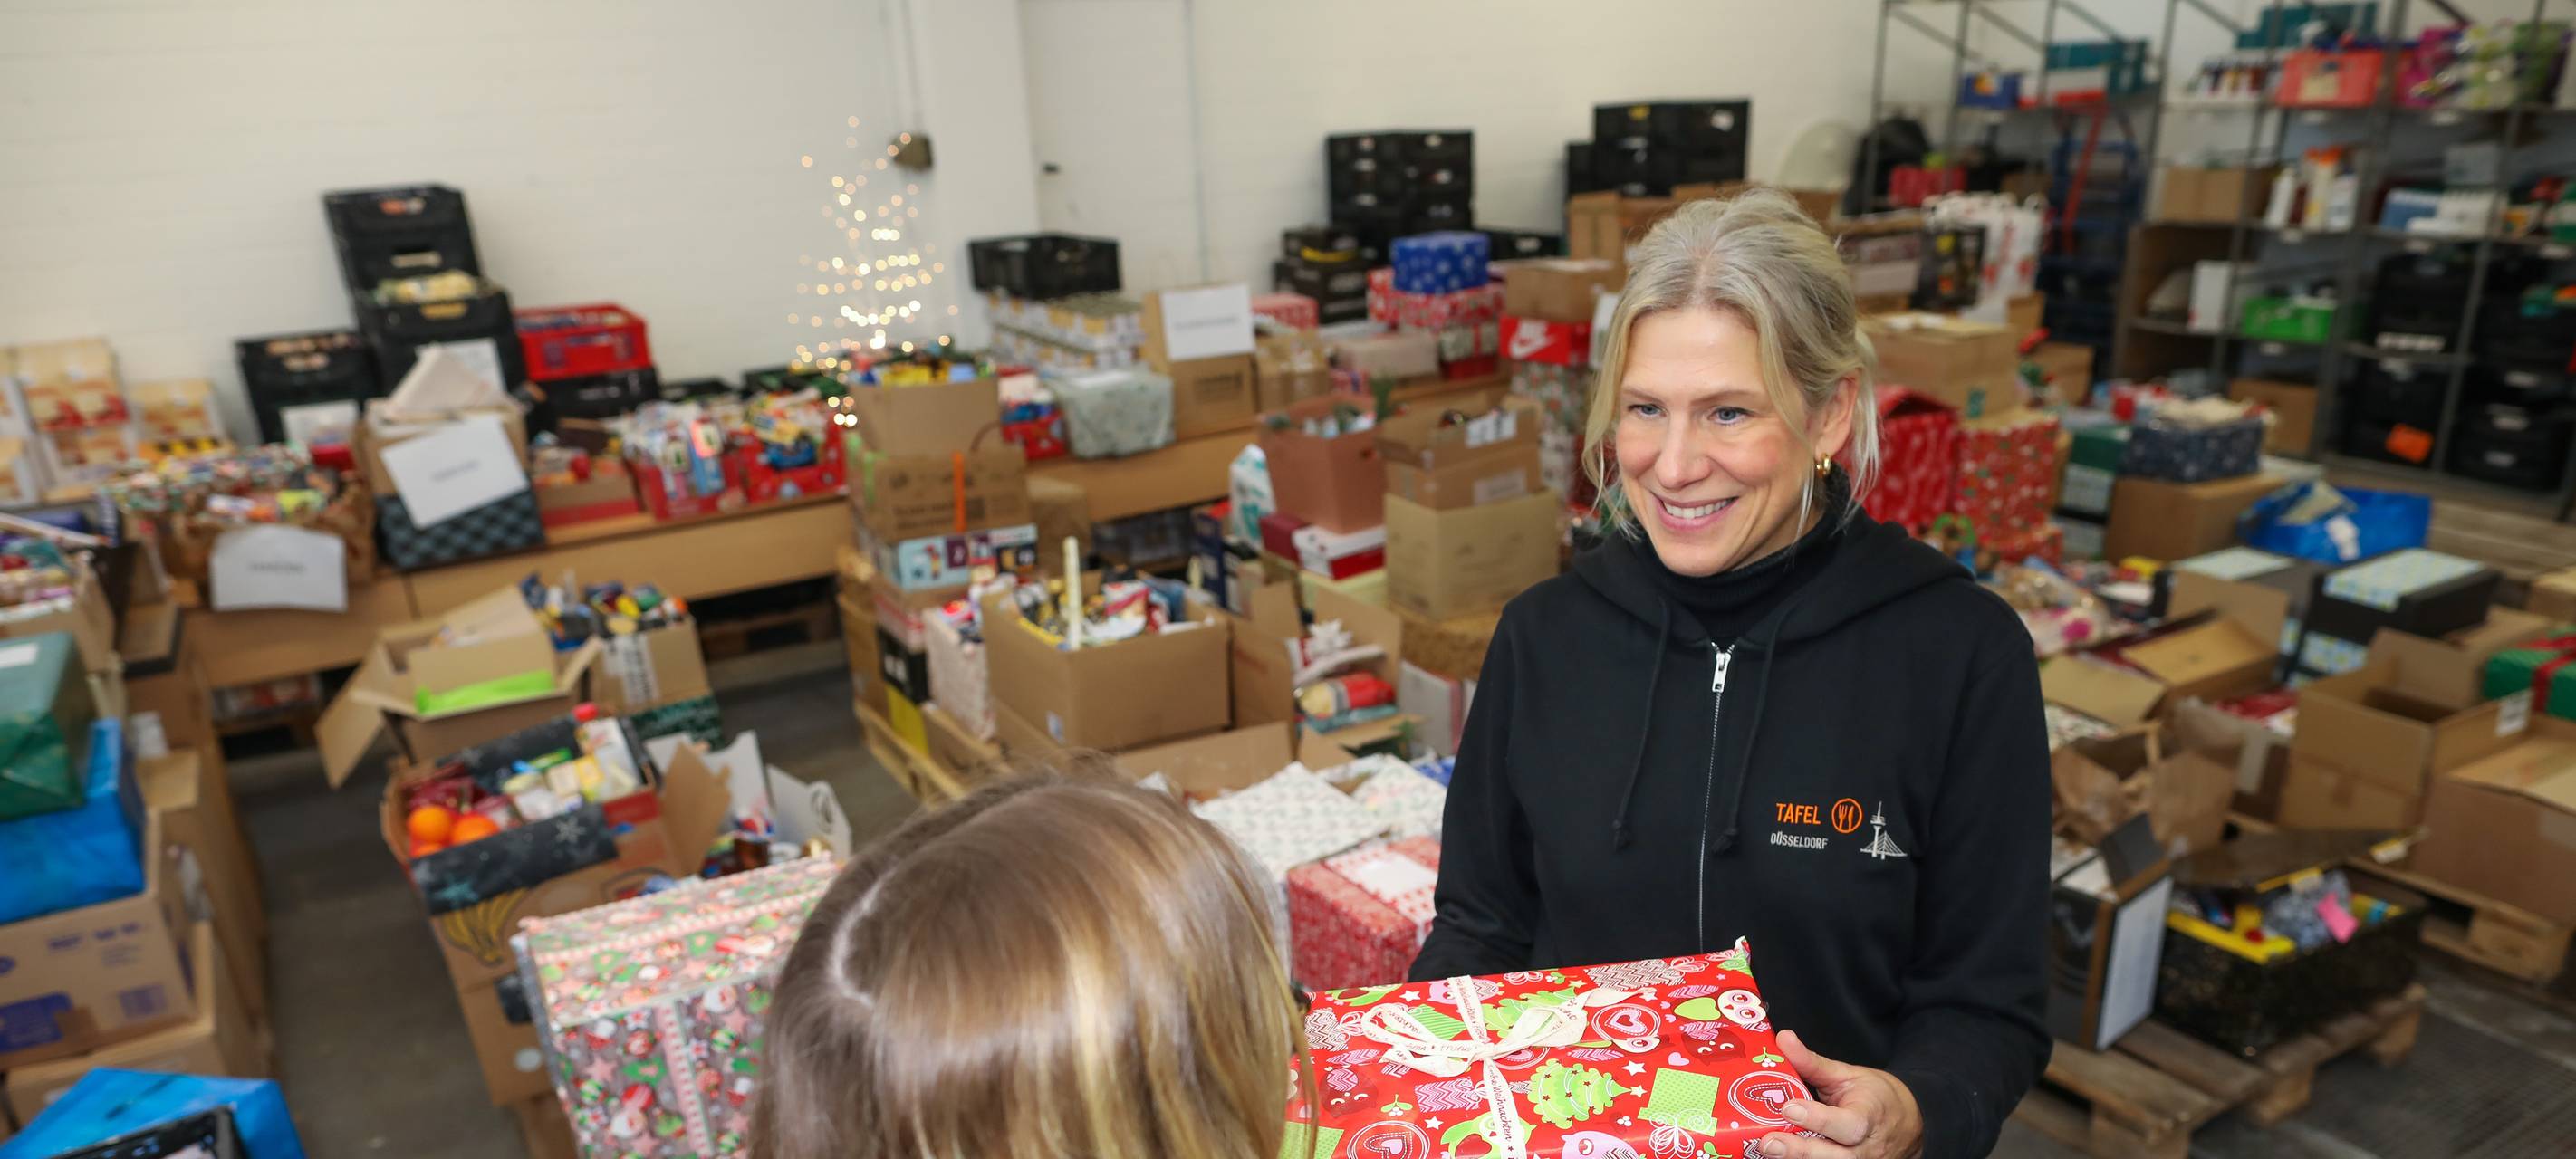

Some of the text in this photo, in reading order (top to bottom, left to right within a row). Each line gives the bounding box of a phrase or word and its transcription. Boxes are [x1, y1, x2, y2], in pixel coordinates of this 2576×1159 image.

[1776, 803, 1821, 825] TAFEL
[1771, 831, 1828, 849] DÜSSELDORF
[1494, 1086, 1513, 1141] Weihnachten
